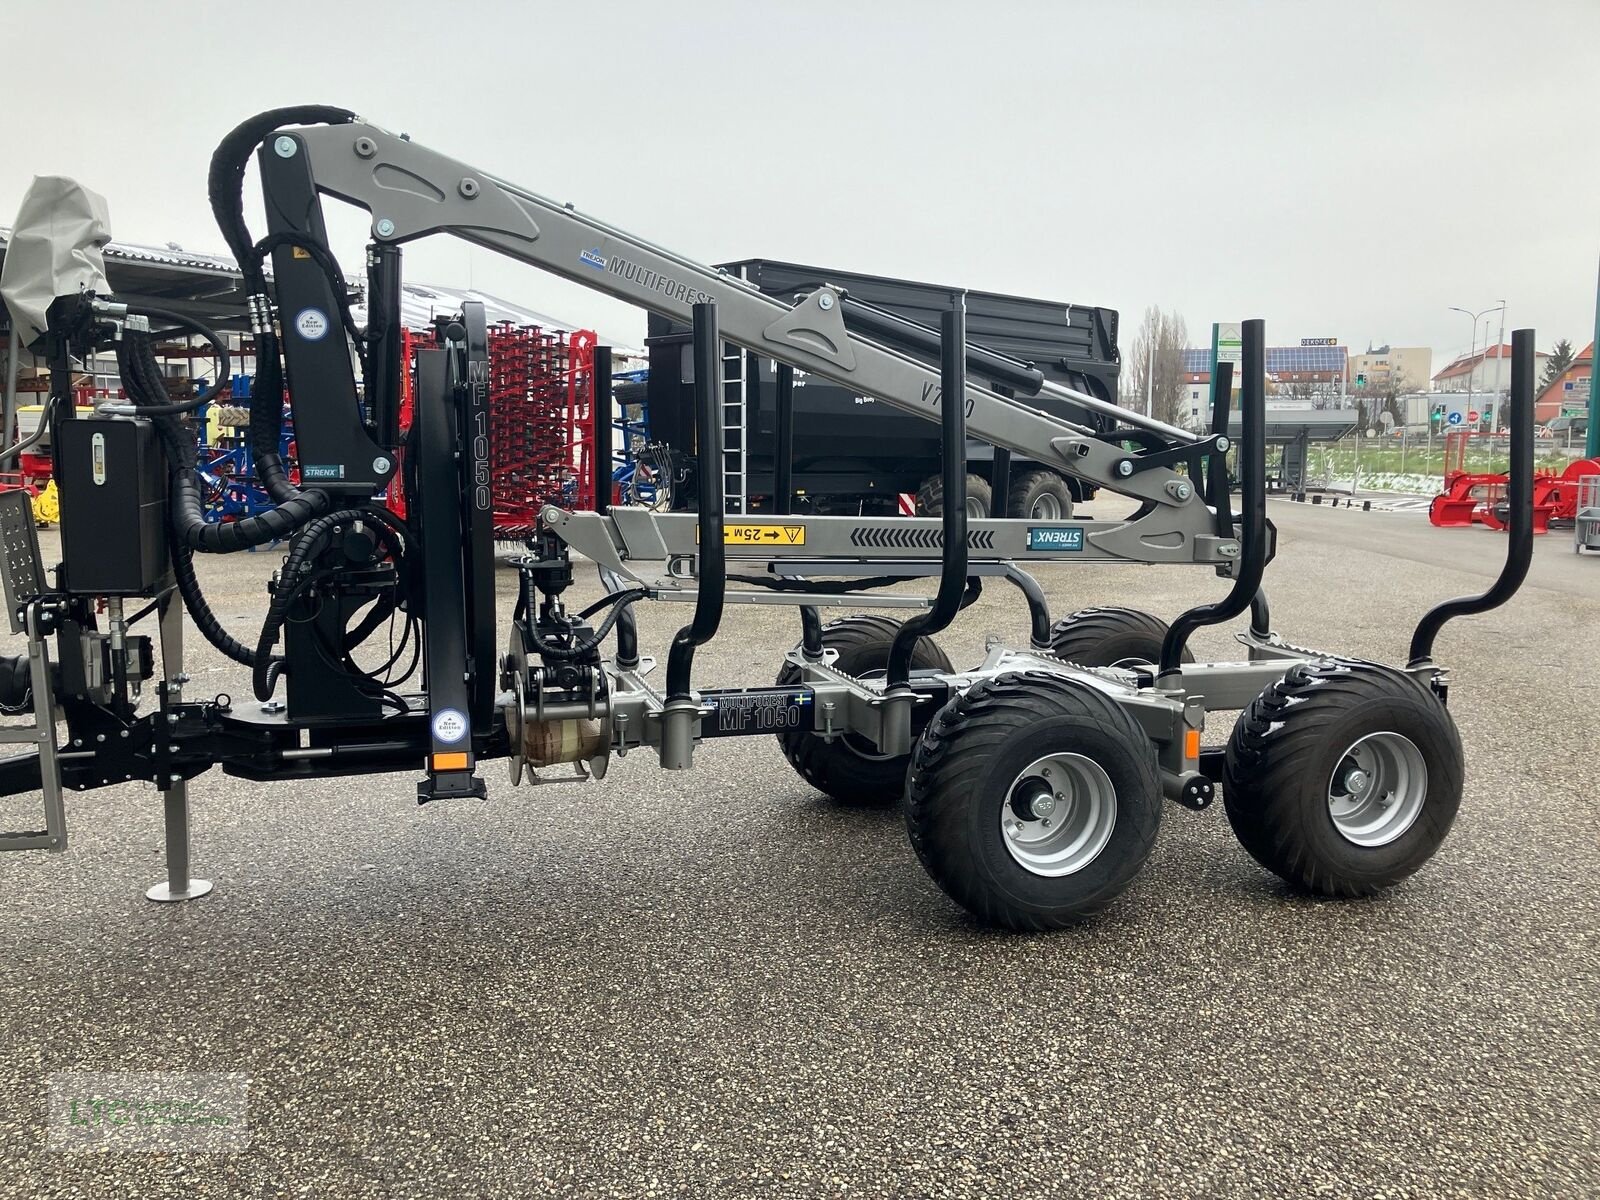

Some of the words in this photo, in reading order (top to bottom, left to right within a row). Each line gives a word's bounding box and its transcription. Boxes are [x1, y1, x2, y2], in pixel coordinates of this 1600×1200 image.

[582, 251, 605, 265] TREJON
[608, 256, 716, 305] MULTIFOREST
[921, 380, 975, 419] V70
[474, 411, 490, 511] 1050
[305, 469, 335, 477] STRENX
[1037, 531, 1080, 543] STRENX
[720, 694, 788, 709] MULTIFOREST
[720, 707, 751, 730] MF
[754, 705, 800, 729] 1050
